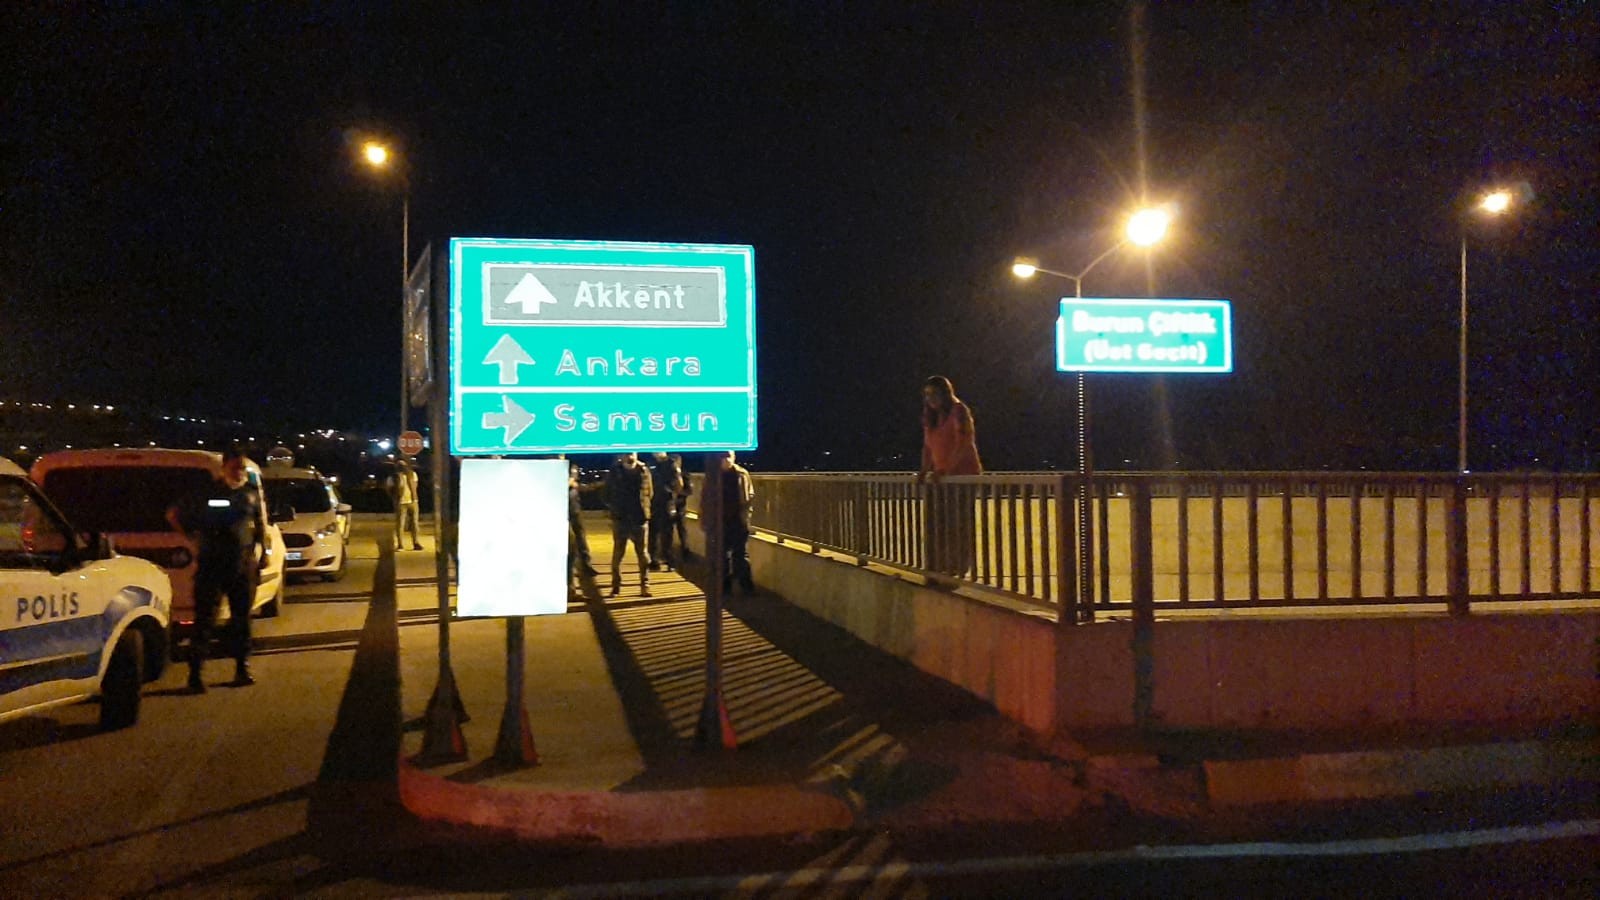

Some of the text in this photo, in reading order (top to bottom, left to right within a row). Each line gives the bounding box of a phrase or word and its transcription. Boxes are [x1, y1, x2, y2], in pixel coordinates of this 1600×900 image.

[574, 281, 685, 310] Akkent
[556, 350, 701, 376] Ankara
[554, 404, 719, 432] Samsun
[17, 588, 79, 622] POLİS
